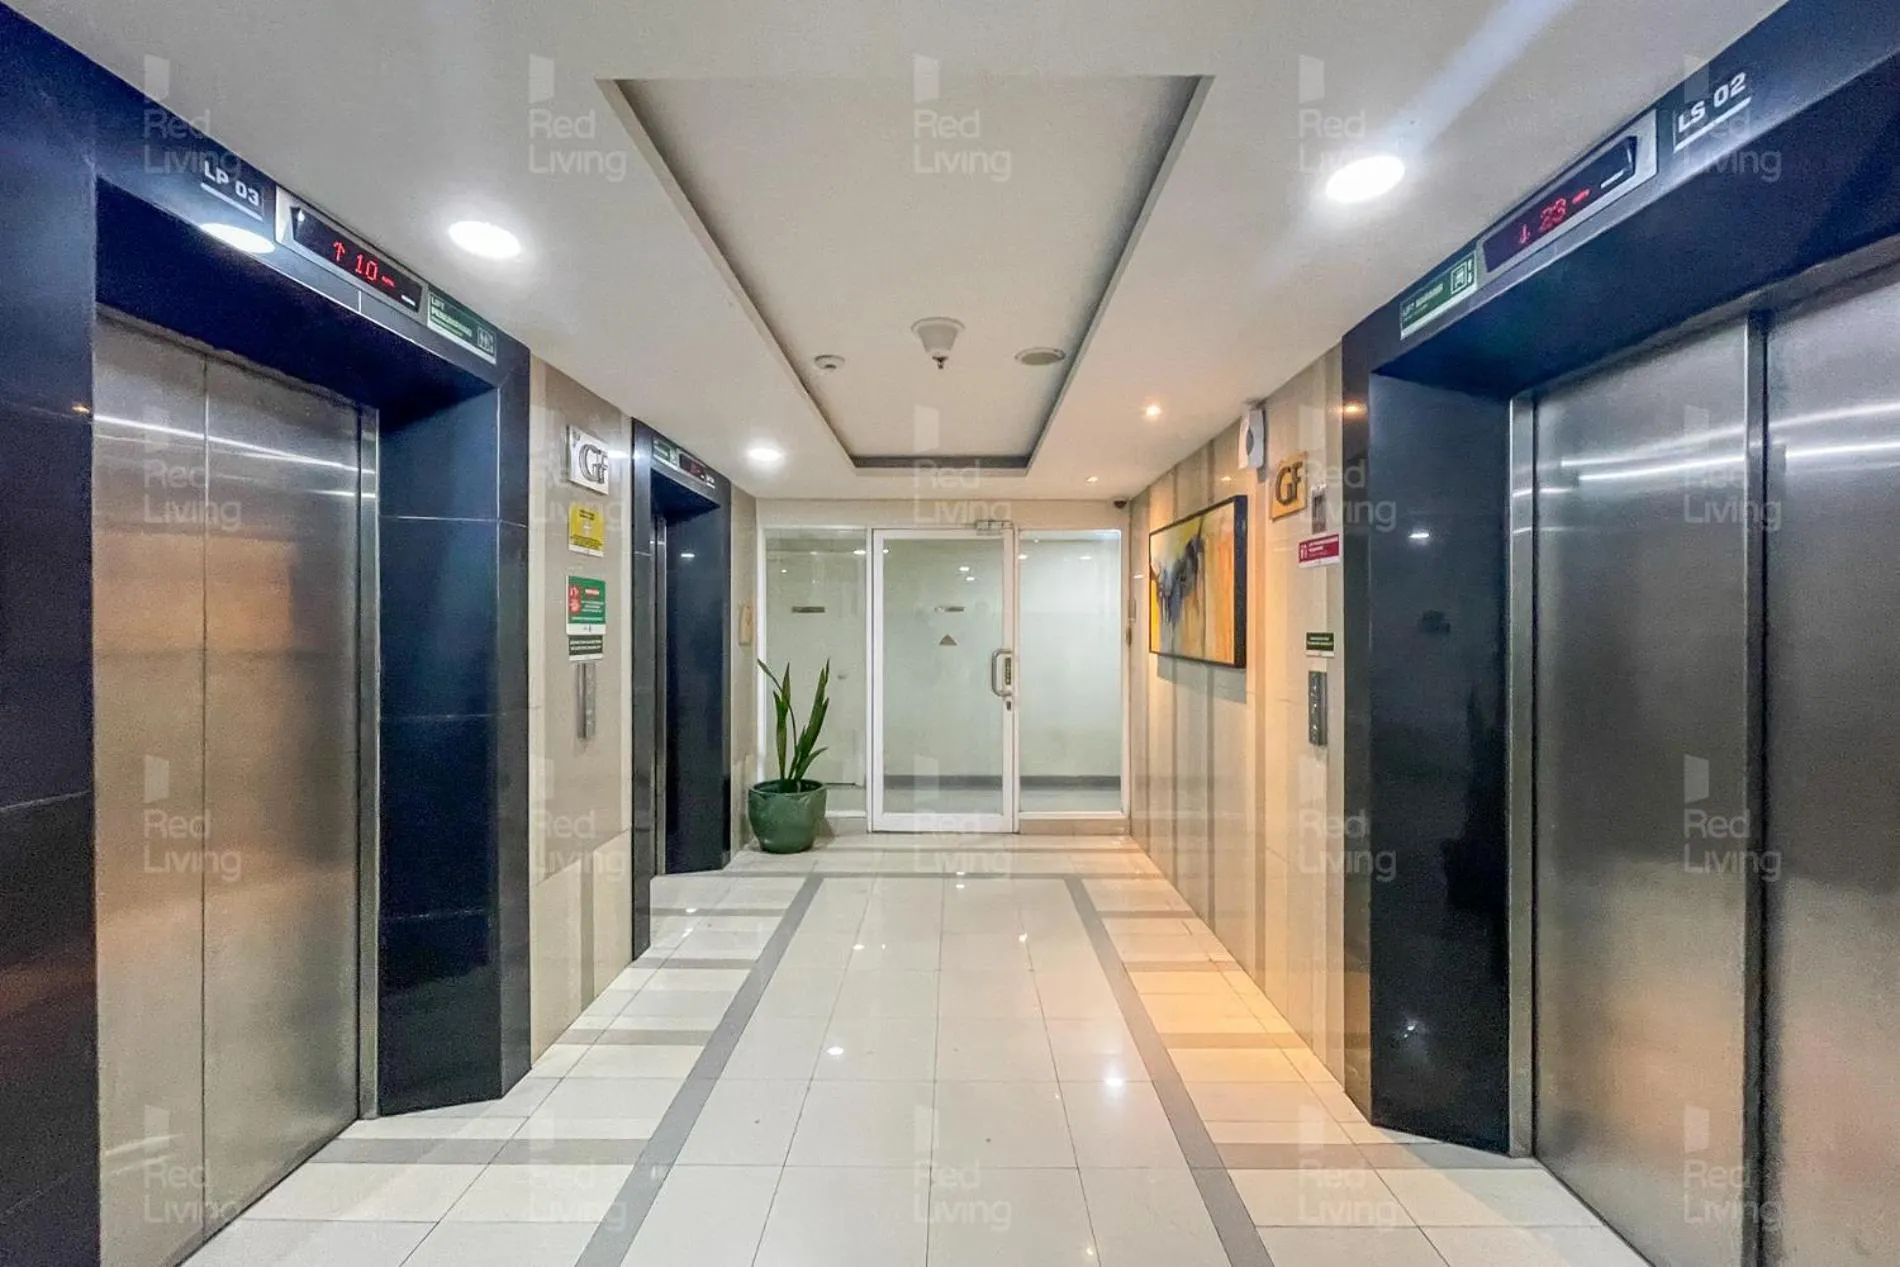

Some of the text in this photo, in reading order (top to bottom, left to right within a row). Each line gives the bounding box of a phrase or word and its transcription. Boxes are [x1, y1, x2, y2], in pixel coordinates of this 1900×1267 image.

[1678, 72, 1746, 133] LS 02
[204, 160, 260, 206] LP 03
[355, 254, 378, 281] 10
